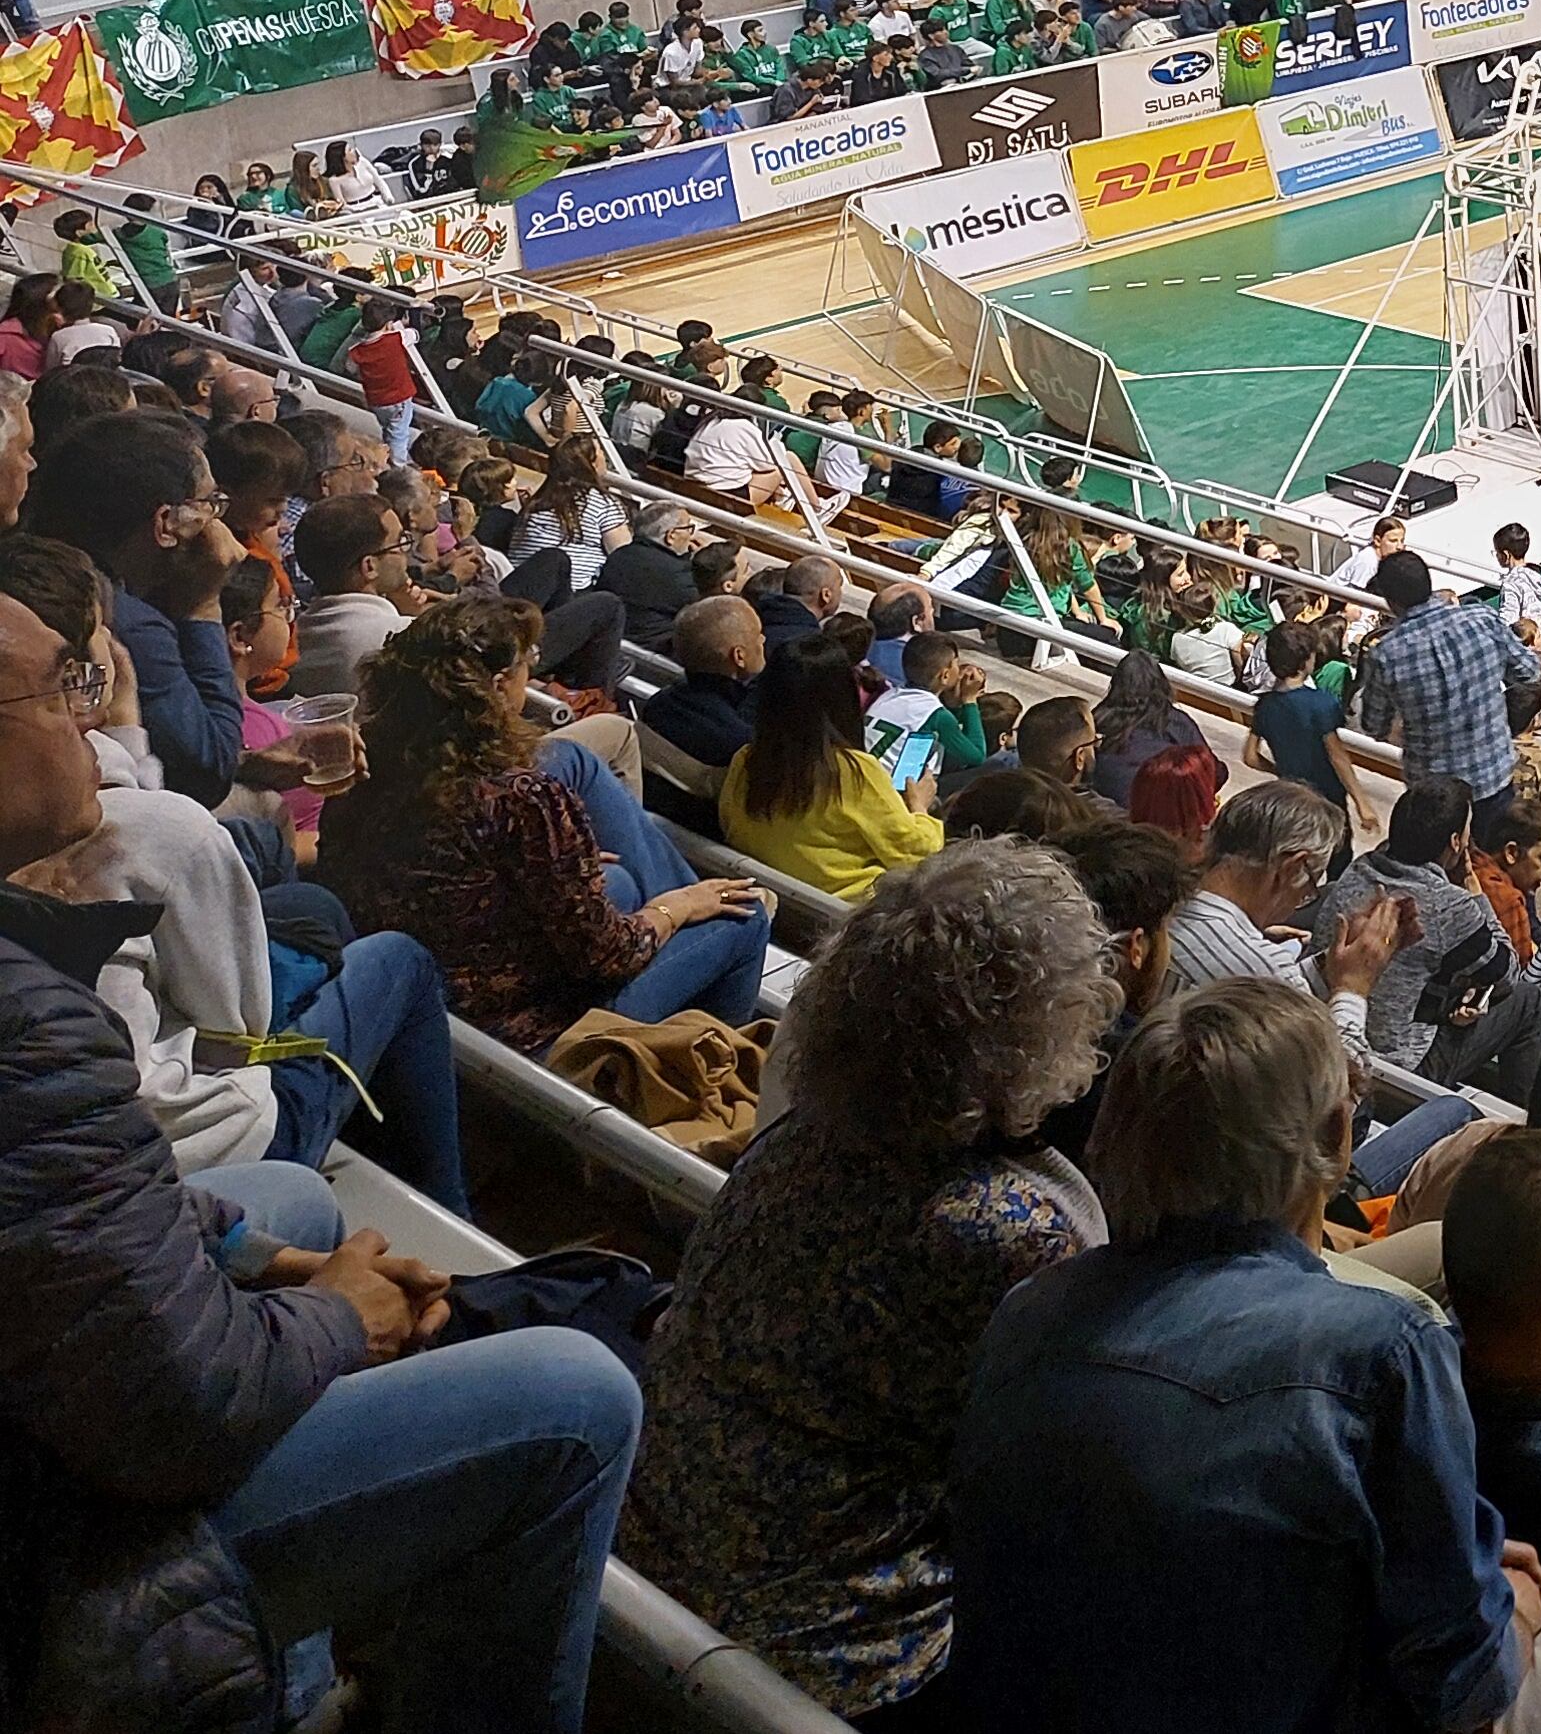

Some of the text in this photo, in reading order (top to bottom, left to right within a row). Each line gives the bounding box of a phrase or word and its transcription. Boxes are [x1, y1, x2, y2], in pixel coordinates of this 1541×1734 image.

[795, 114, 852, 132] MANANTIAL
[1381, 115, 1406, 136] BUS
[750, 116, 906, 174] Fontecabras
[802, 157, 850, 175] MINERAL
[851, 143, 900, 162] NATURAL
[1095, 140, 1249, 207] DHL
